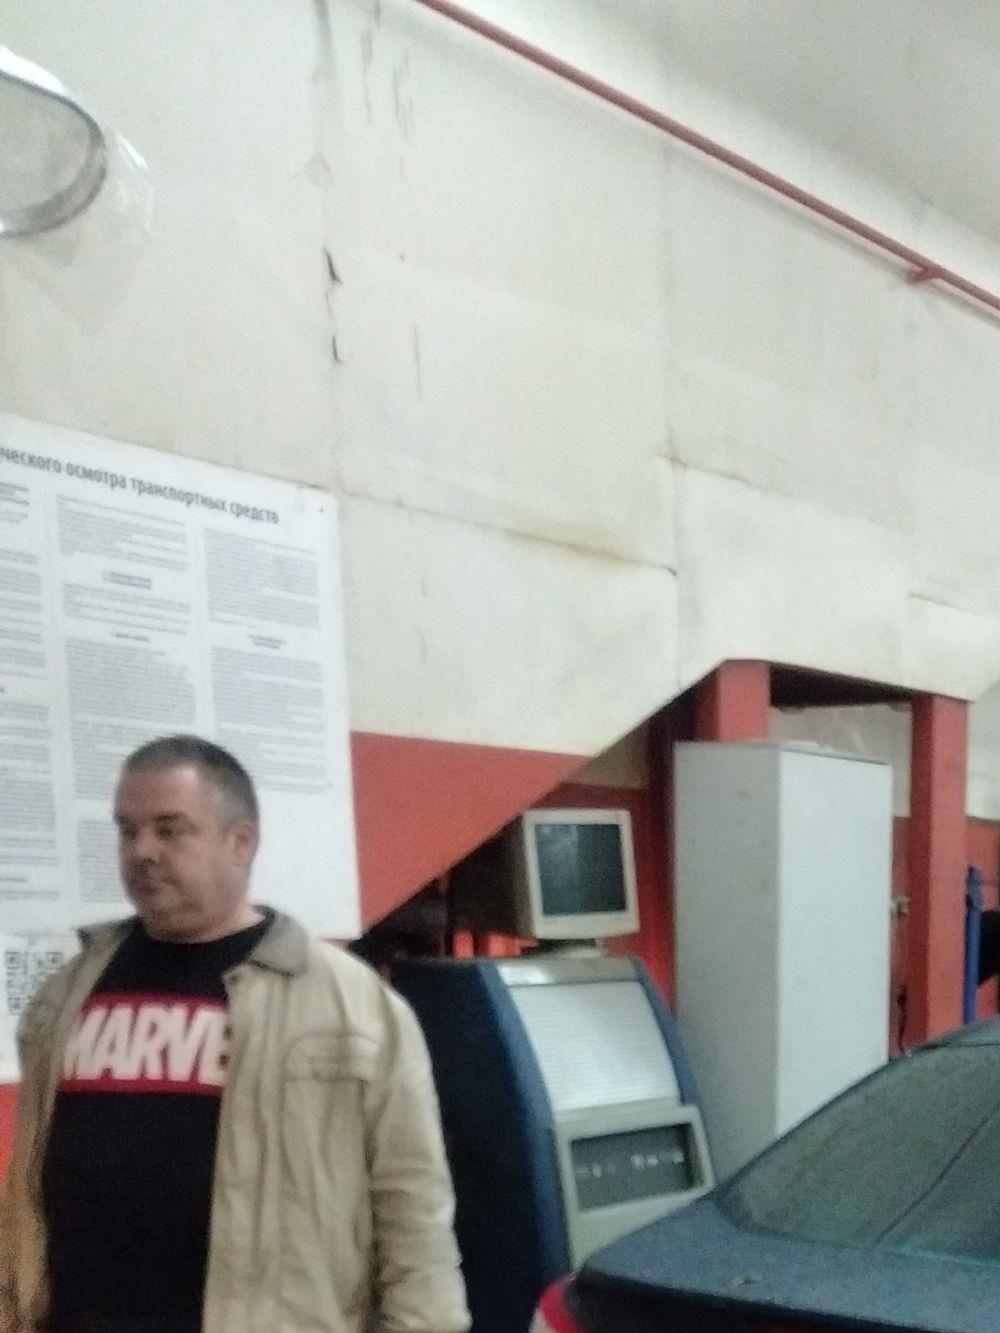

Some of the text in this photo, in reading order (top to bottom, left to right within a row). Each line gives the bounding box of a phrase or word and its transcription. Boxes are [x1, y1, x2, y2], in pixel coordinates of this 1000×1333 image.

[66, 462, 127, 490] осмотра
[130, 478, 227, 511] транспортных
[229, 502, 280, 525] средств
